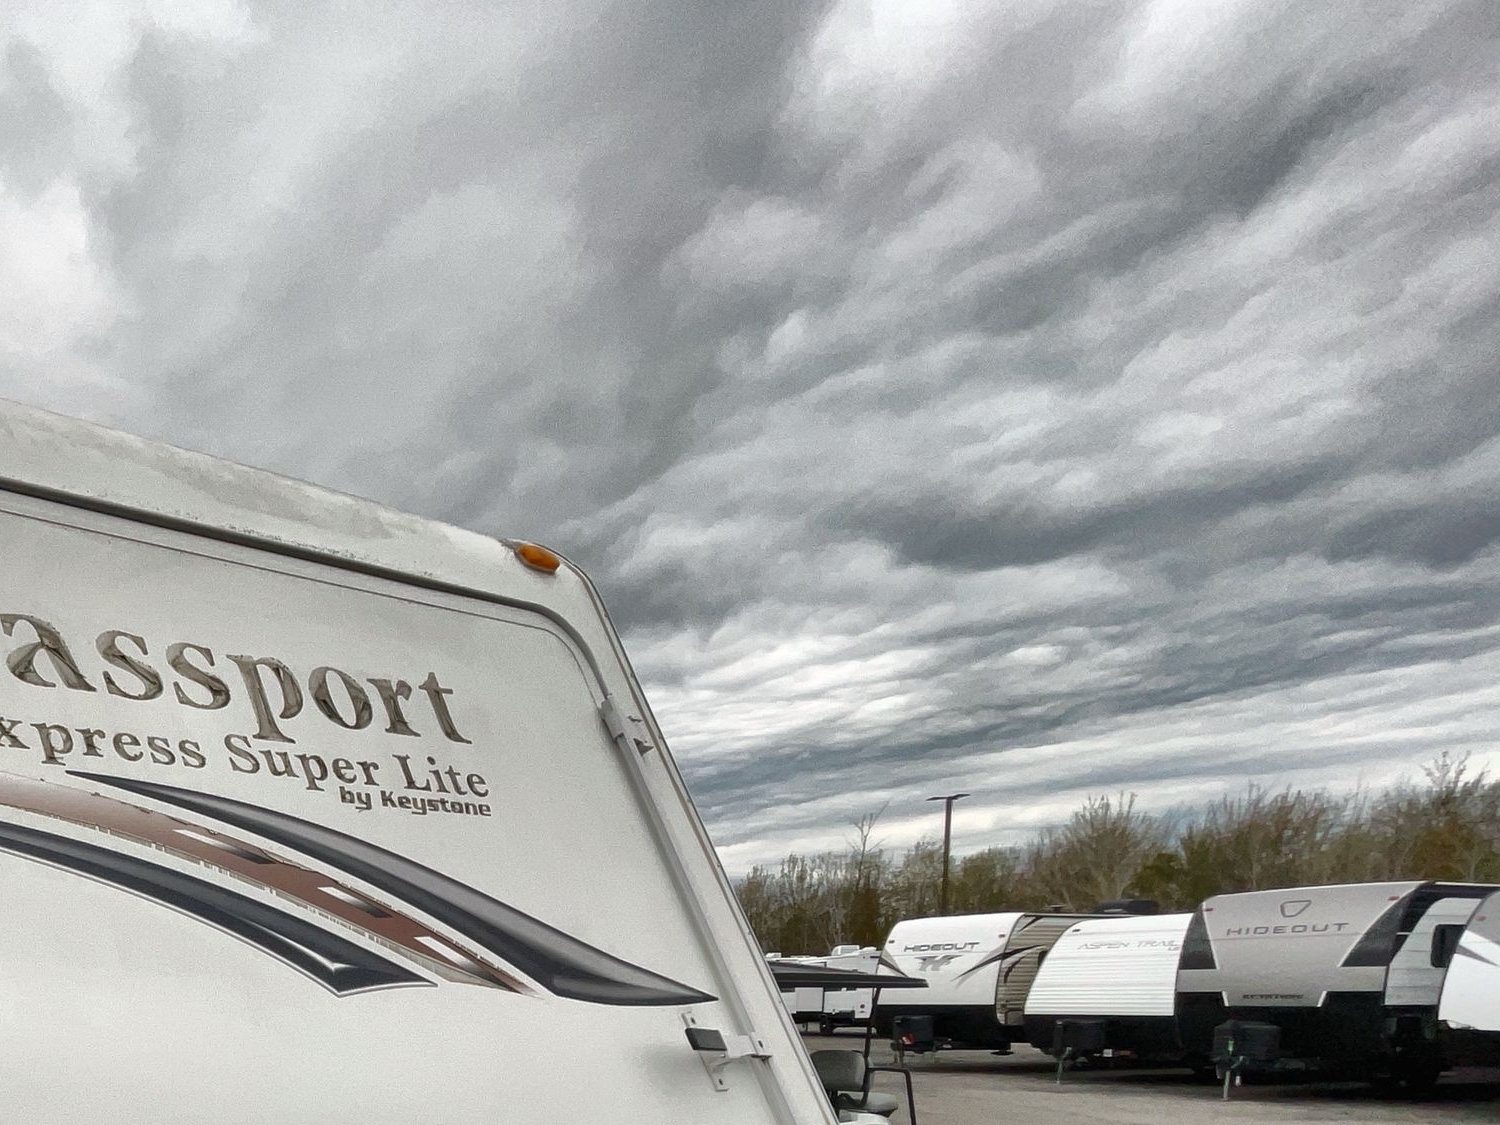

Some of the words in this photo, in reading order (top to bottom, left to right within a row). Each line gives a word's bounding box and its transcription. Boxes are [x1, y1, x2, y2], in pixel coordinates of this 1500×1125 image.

[224, 733, 381, 792] Super
[391, 752, 490, 798] Lite
[338, 785, 373, 812] by
[379, 789, 492, 817] Keystone
[1226, 922, 1349, 936] HIDEOUT
[903, 941, 981, 953] HIDEOUT
[1077, 941, 1130, 950] ASPEN
